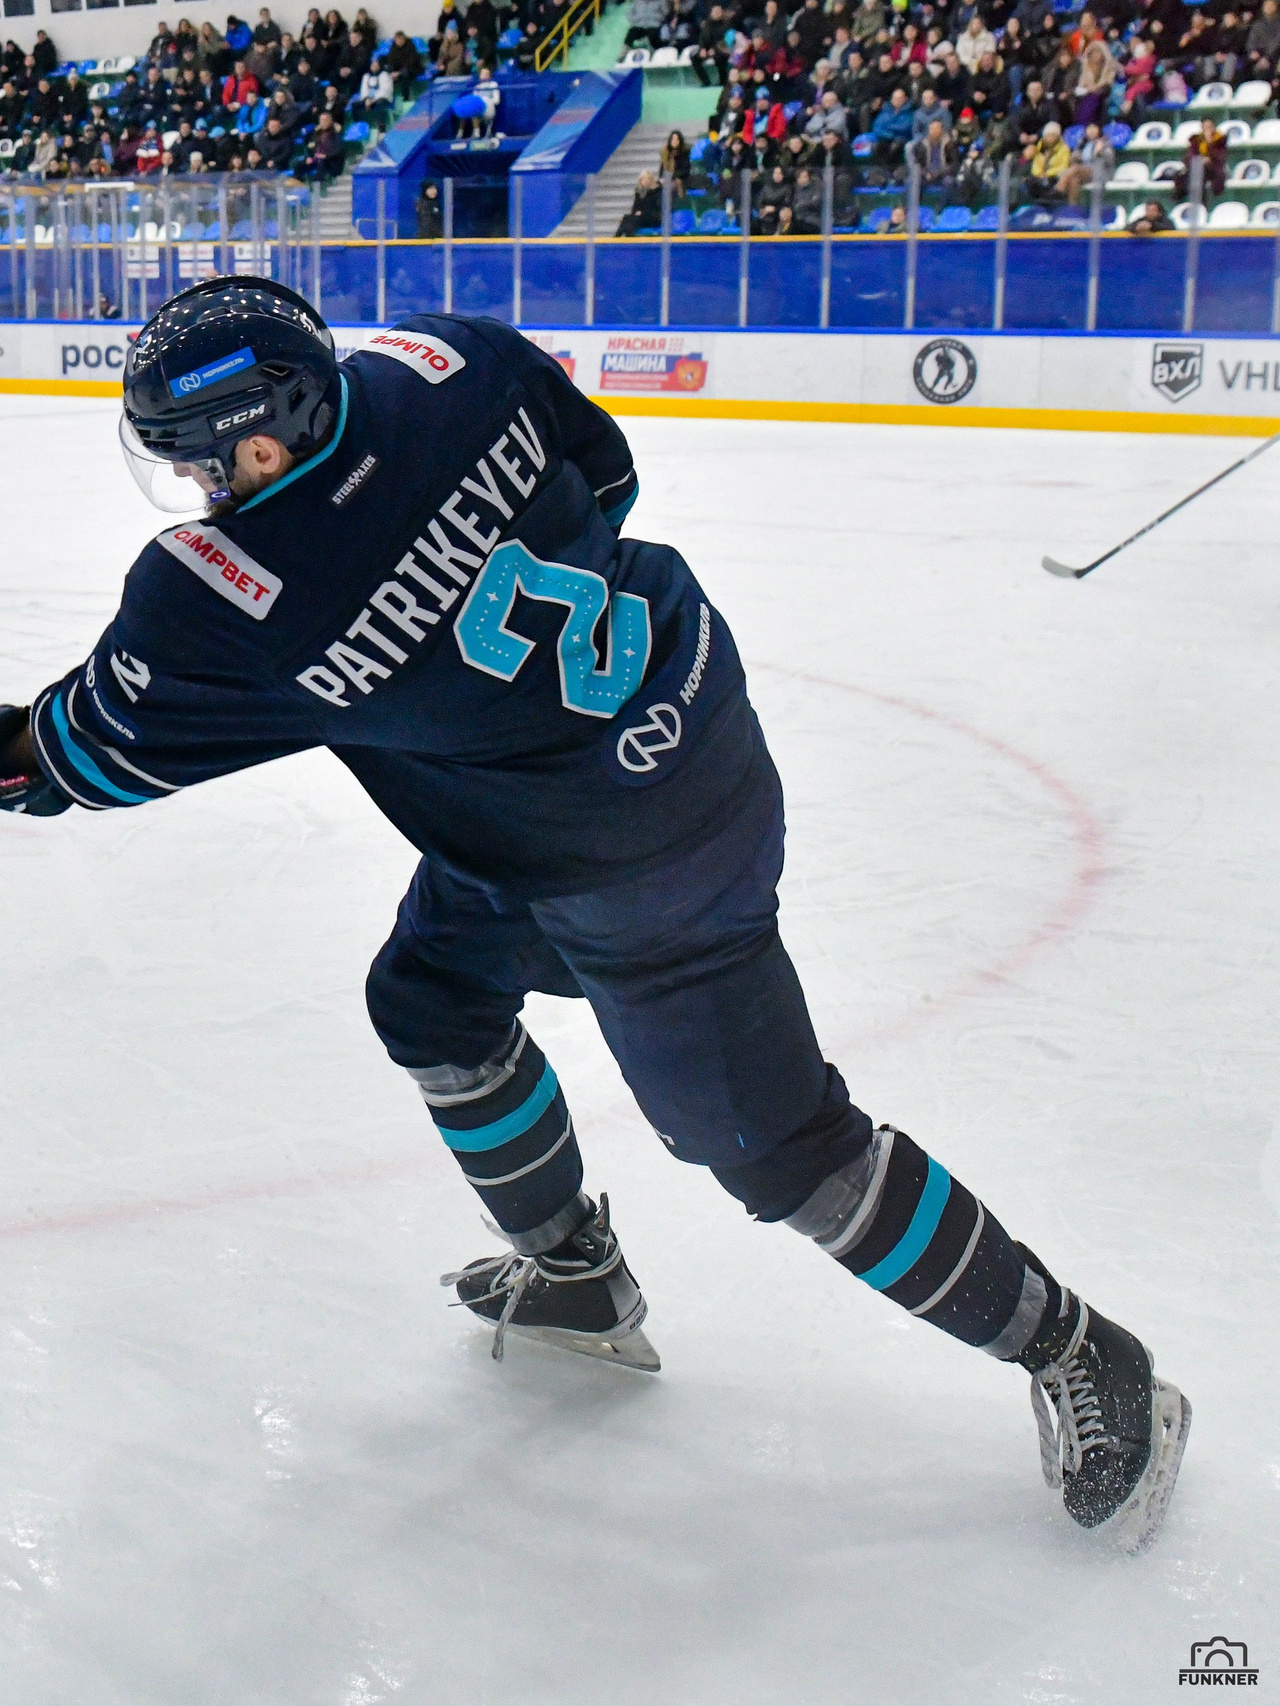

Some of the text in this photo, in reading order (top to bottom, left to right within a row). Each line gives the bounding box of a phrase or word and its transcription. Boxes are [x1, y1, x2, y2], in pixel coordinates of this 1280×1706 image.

[62, 344, 123, 375] рос
[607, 338, 666, 351] КРАСНАЯ
[604, 354, 667, 372] МАШИНА
[215, 404, 265, 431] CCM
[296, 406, 547, 708] PATRIKEYEV
[452, 538, 651, 719] 2
[679, 602, 711, 706] НОРНИКЕЛЬ
